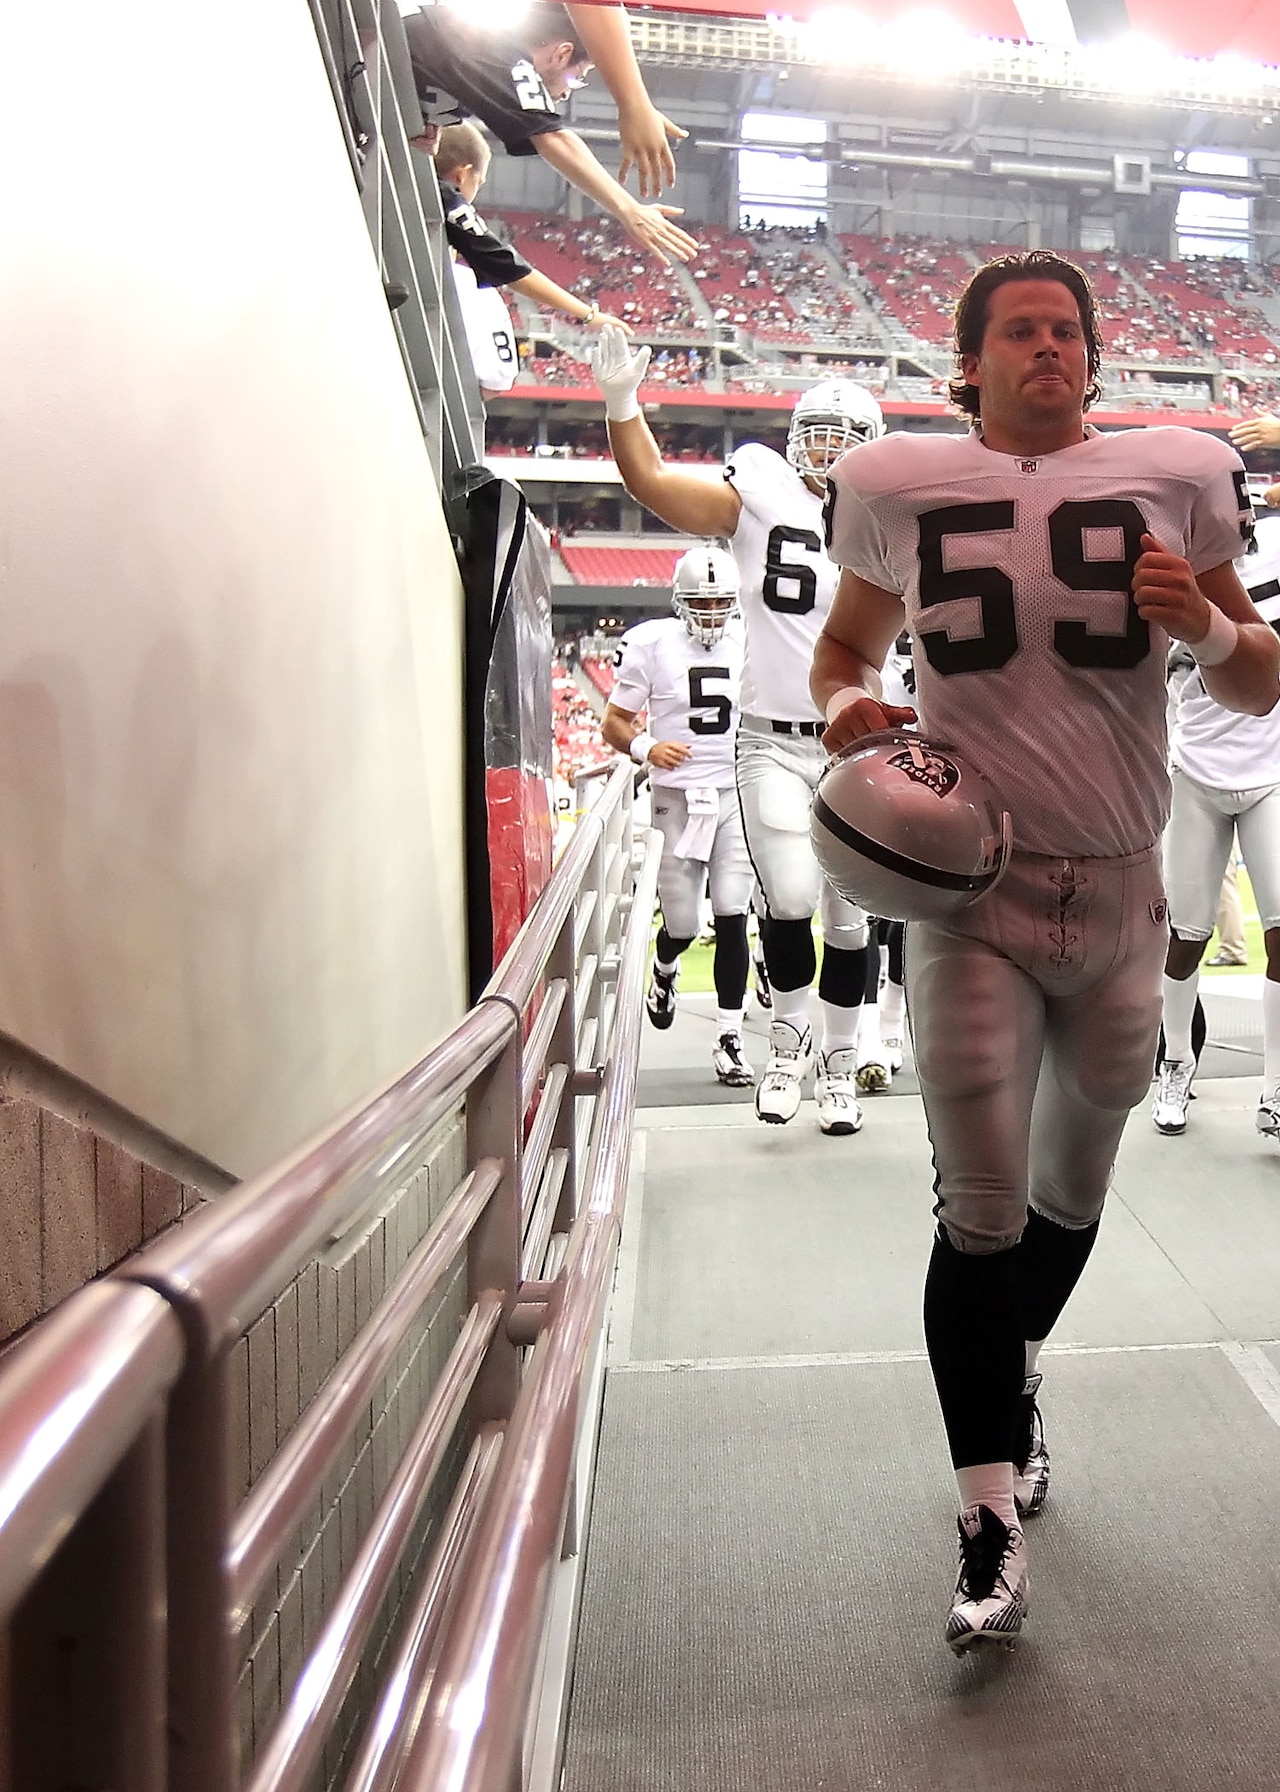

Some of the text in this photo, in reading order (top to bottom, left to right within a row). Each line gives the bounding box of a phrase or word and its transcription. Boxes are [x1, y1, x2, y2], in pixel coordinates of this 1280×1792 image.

[762, 525, 822, 615] 6
[917, 499, 1151, 676] 59
[688, 667, 732, 735] 5
